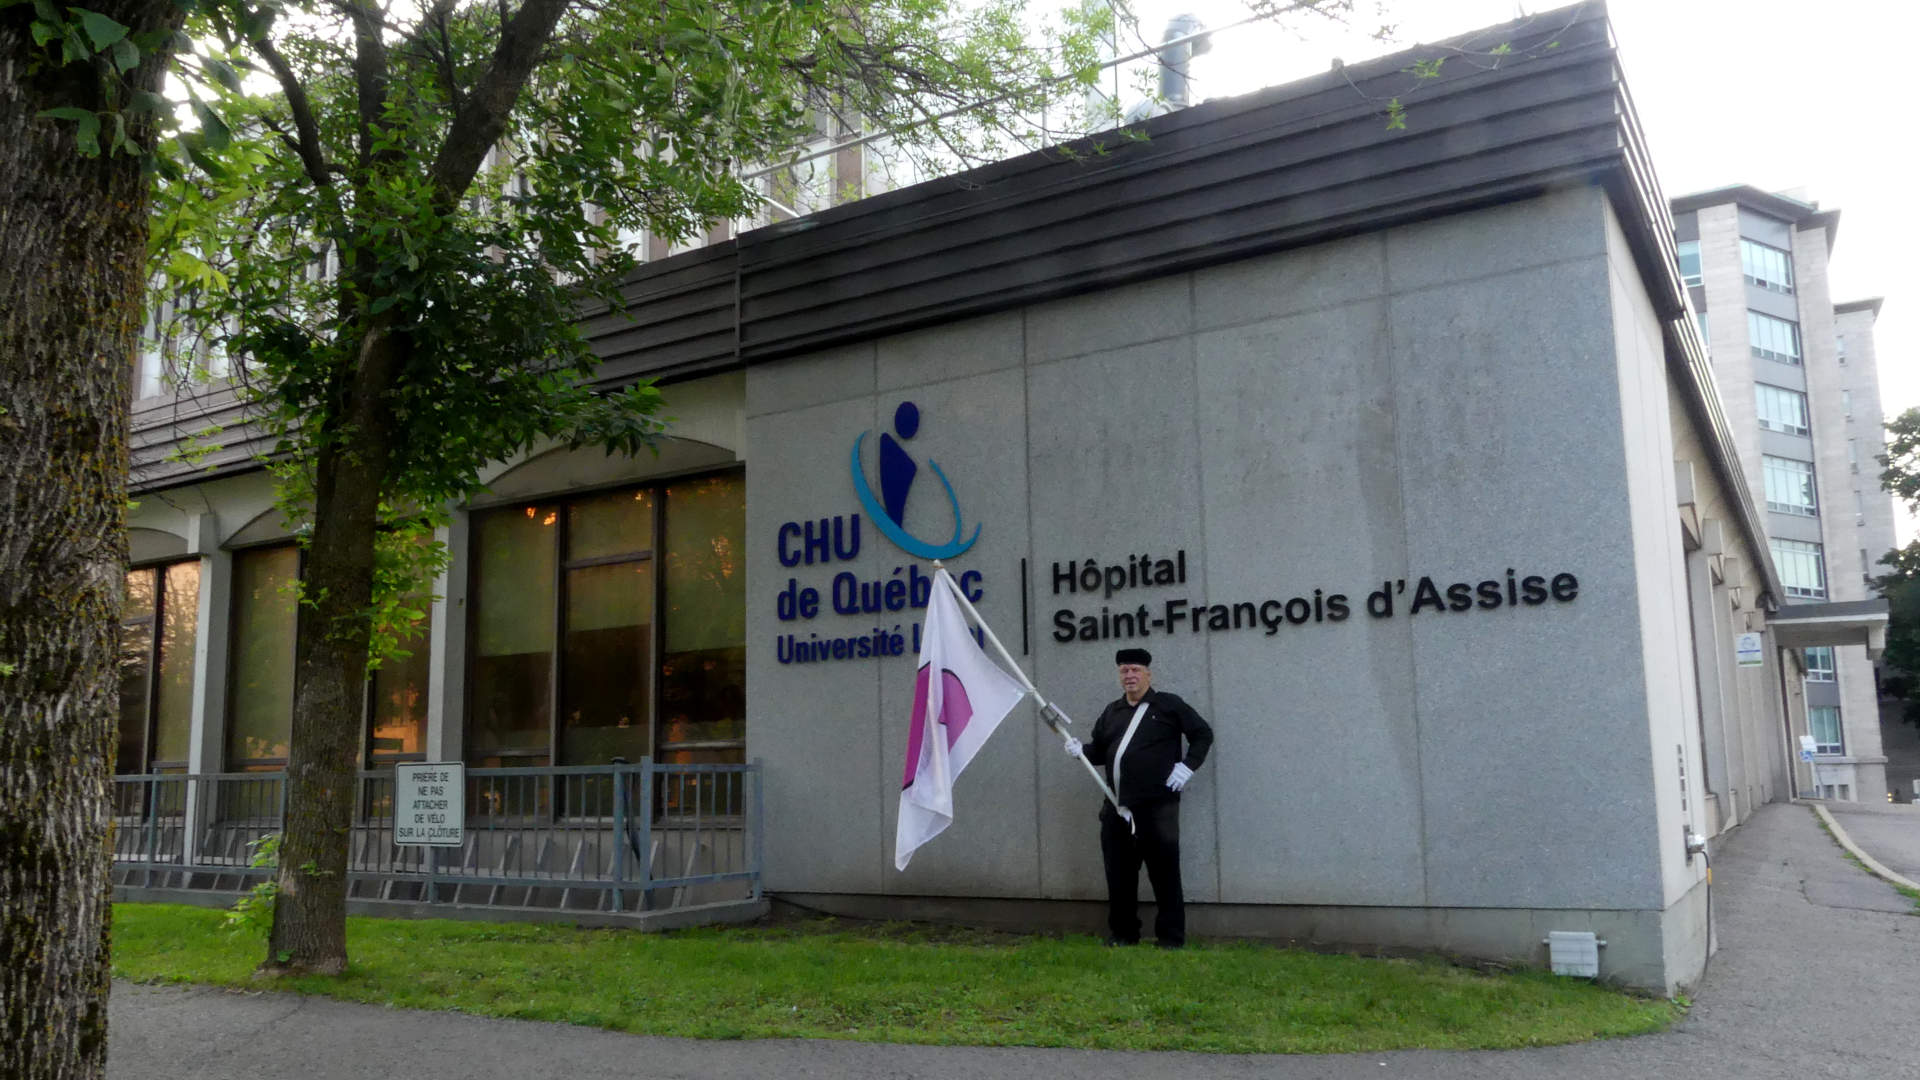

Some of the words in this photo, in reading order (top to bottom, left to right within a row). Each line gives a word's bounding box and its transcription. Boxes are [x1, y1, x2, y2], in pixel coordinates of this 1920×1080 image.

[778, 514, 860, 568] CHU
[1052, 550, 1186, 599] Hôpital
[777, 578, 819, 621] de
[832, 564, 983, 615] Québc
[1053, 588, 1350, 643] Saint-François
[777, 625, 904, 665] Université
[440, 772, 449, 782] DE
[418, 786, 428, 796] NE
[430, 785, 444, 796] PAS
[412, 799, 448, 810] ATTACHER
[414, 814, 424, 824] DE
[399, 827, 414, 838] SUR
[416, 827, 425, 838] LA
